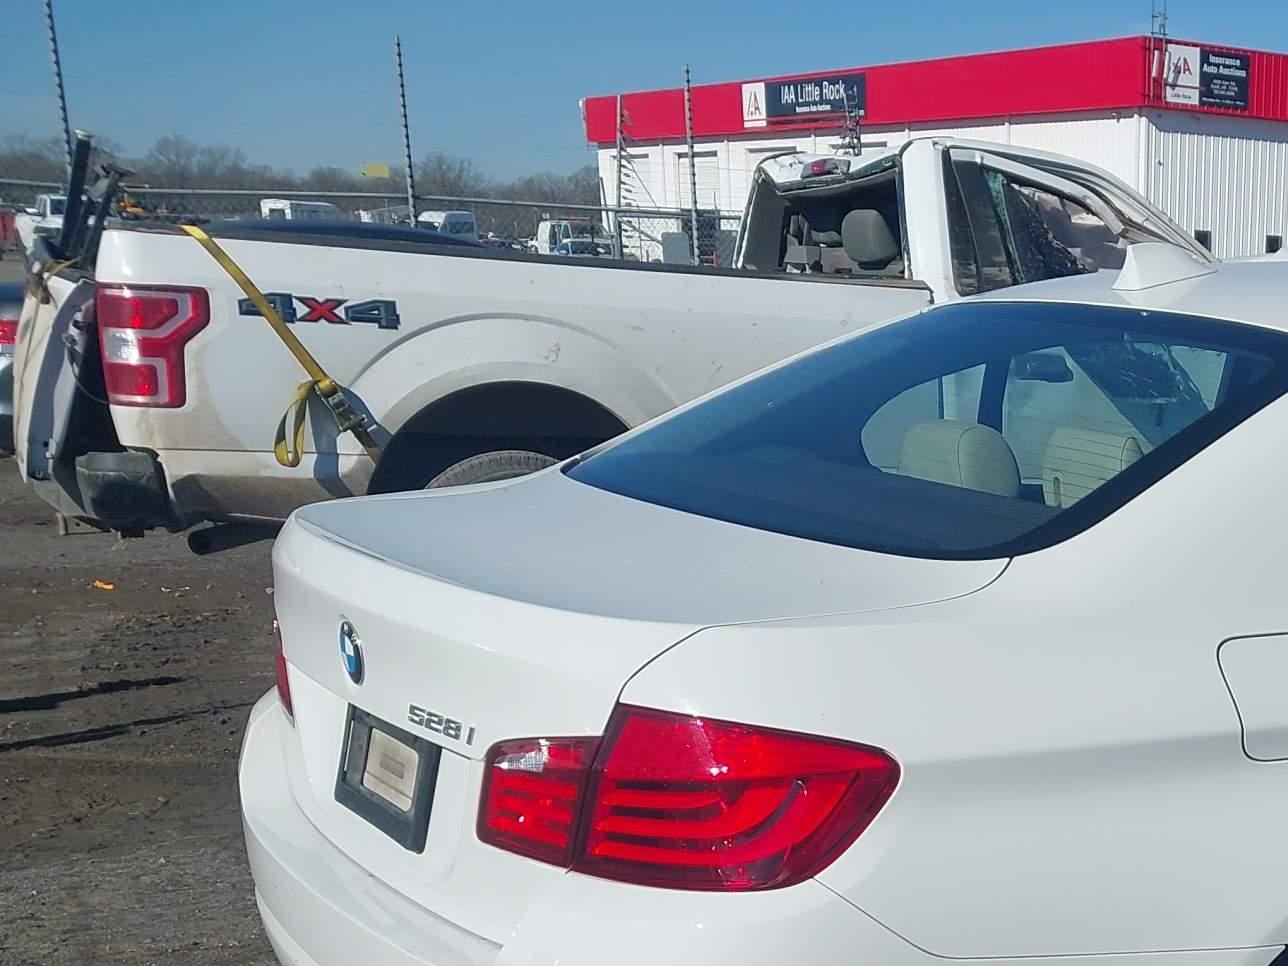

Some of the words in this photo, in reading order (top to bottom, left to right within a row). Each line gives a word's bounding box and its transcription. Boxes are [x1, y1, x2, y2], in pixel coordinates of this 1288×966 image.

[1209, 54, 1240, 66] Insurance
[1202, 63, 1217, 73] Auto
[1219, 65, 1246, 77] Auctions
[781, 85, 796, 104] IAA
[798, 82, 820, 102] Little
[823, 80, 845, 100] Rock
